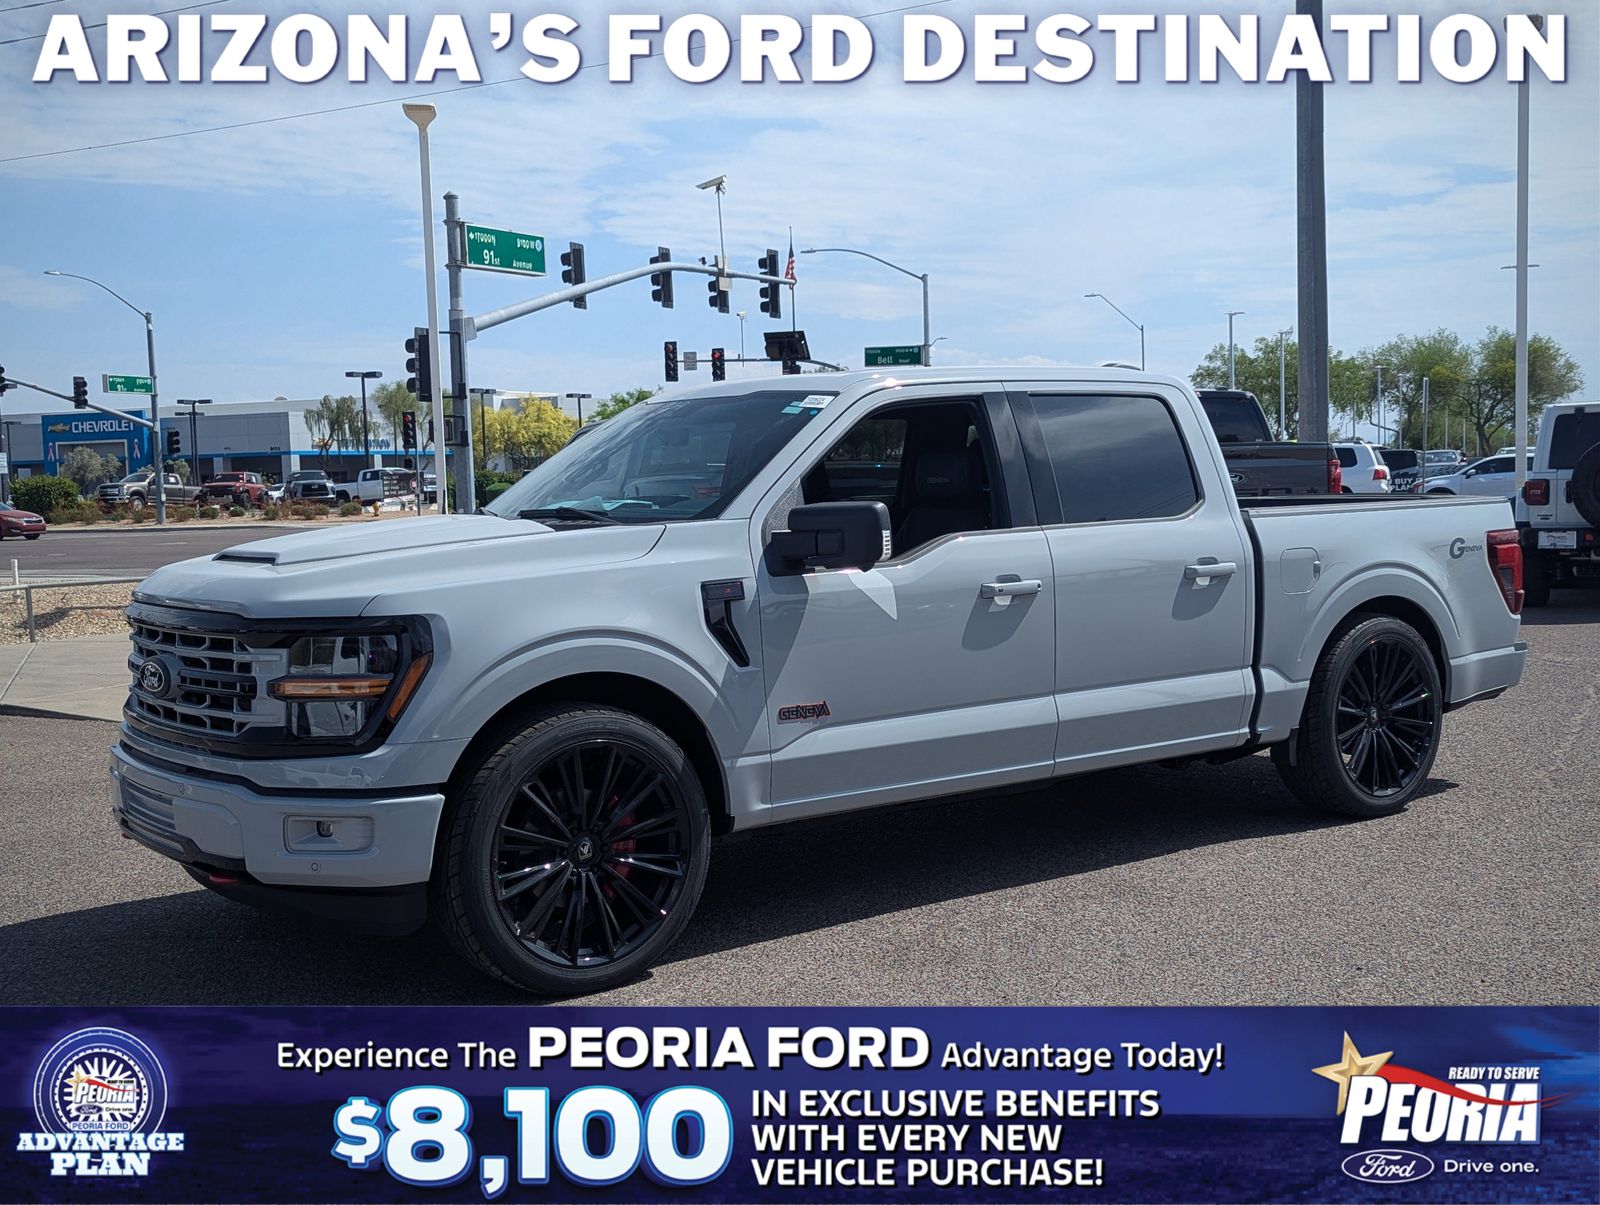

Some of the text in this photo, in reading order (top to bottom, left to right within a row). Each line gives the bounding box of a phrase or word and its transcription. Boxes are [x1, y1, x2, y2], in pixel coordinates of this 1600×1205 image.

[483, 249, 533, 270] 91st Avenue
[877, 356, 893, 364] Bell
[72, 420, 134, 433] CHEVROLET
[1449, 537, 1483, 559] GENEVA
[778, 700, 831, 721] GENEVA
